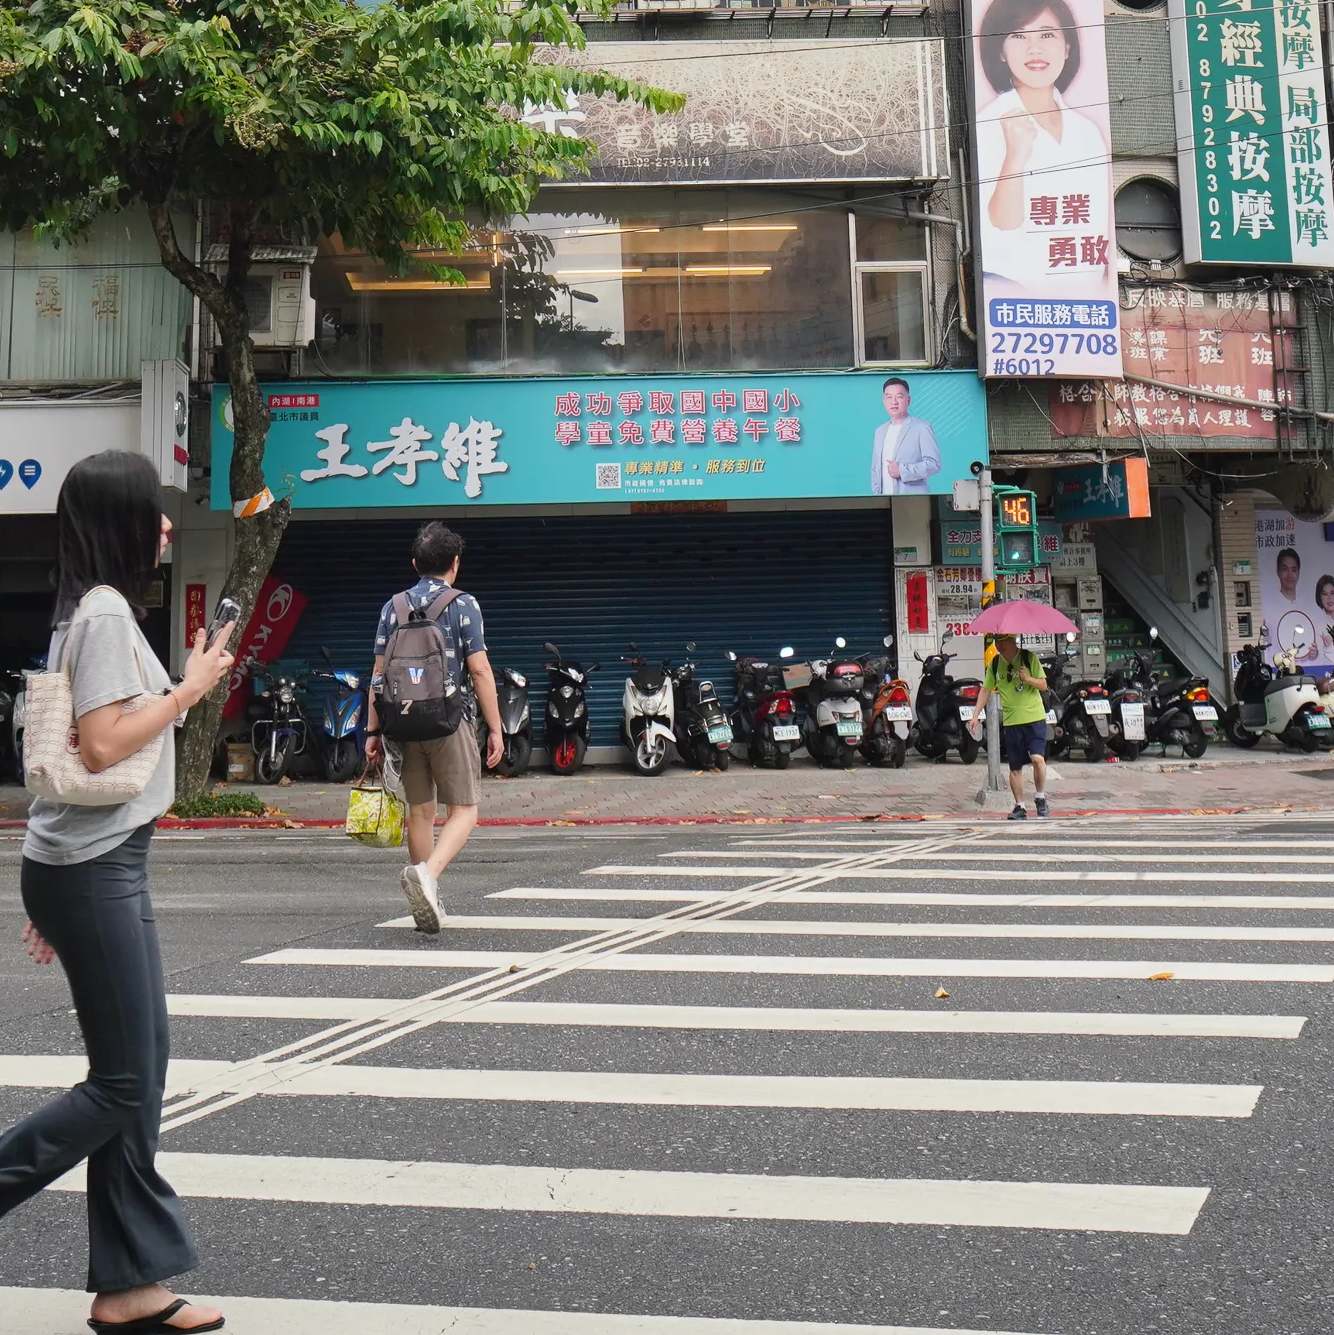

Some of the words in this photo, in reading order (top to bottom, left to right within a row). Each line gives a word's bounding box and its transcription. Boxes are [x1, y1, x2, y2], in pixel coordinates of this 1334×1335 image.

[1287, 86, 1329, 248] 局部按摩
[1029, 194, 1090, 226] 專業
[1048, 235, 1109, 268] 勇敢
[995, 300, 1111, 327] 市民服務電話
[992, 333, 1118, 356] 27297708
[992, 358, 1055, 376] #6012
[554, 388, 800, 416] 成功爭取國中國小
[554, 417, 801, 446] 學童免費營養午餐
[300, 414, 509, 498] 王孝維
[624, 460, 684, 475] 專業精準
[705, 459, 766, 474] 服務到位
[1004, 498, 1030, 525] 46
[1254, 517, 1295, 532] 港湖加游
[1255, 533, 1296, 548] 市政加速
[226, 624, 272, 702] KYMC
[401, 700, 413, 715] 7
